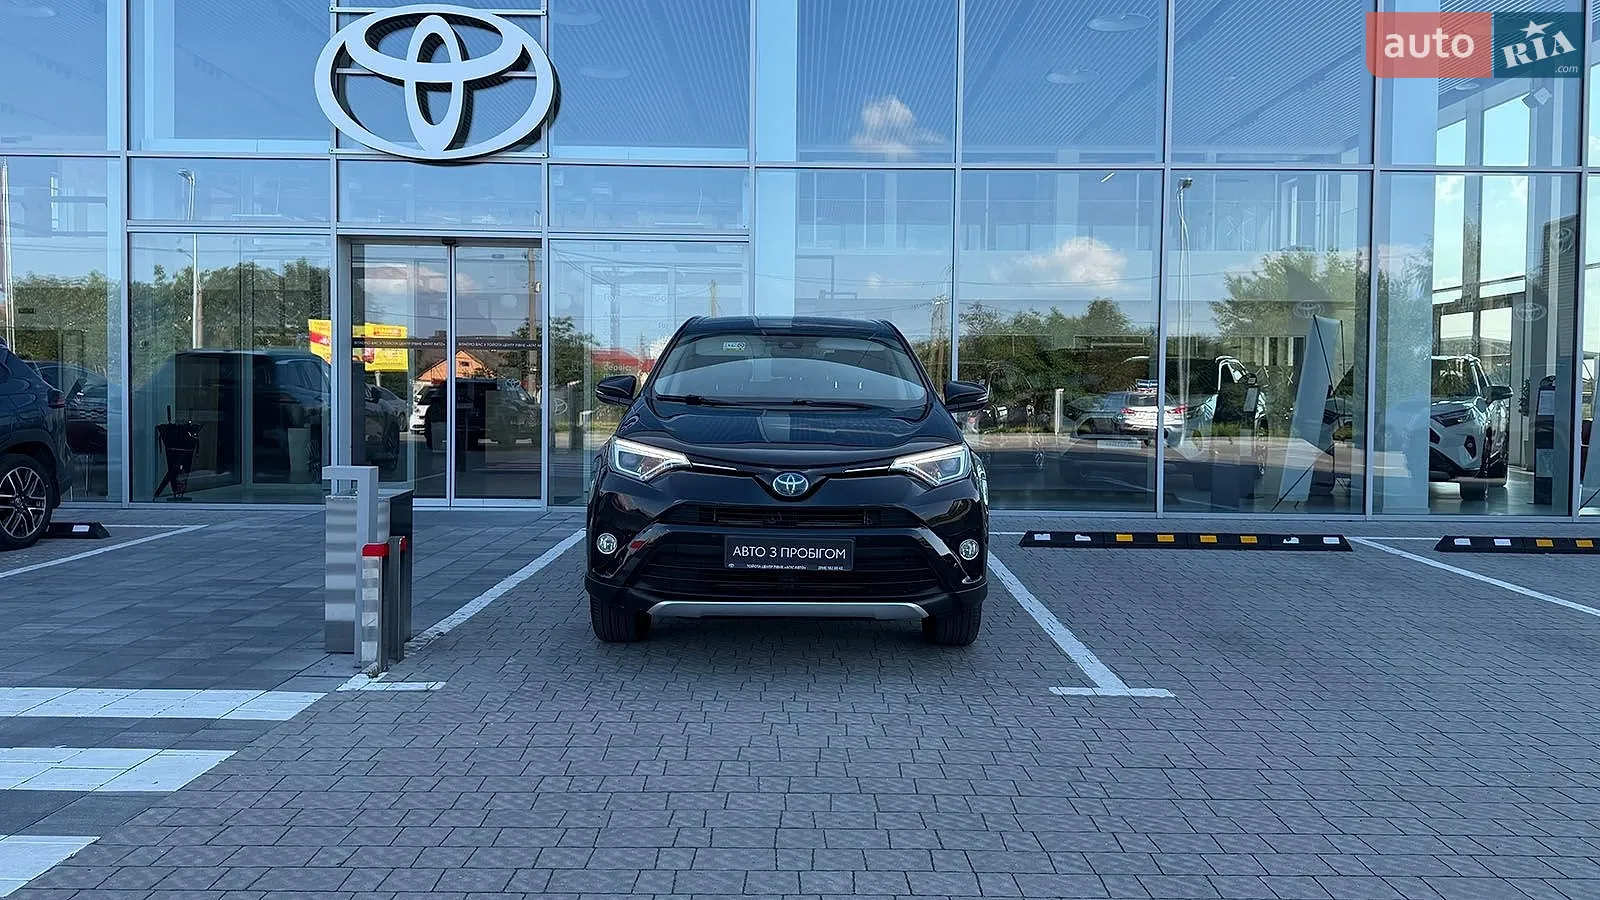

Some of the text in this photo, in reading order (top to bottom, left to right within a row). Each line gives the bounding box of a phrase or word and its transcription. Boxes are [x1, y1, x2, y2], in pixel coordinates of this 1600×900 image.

[732, 545, 846, 559] АВТО З ПРОБІГОМ
